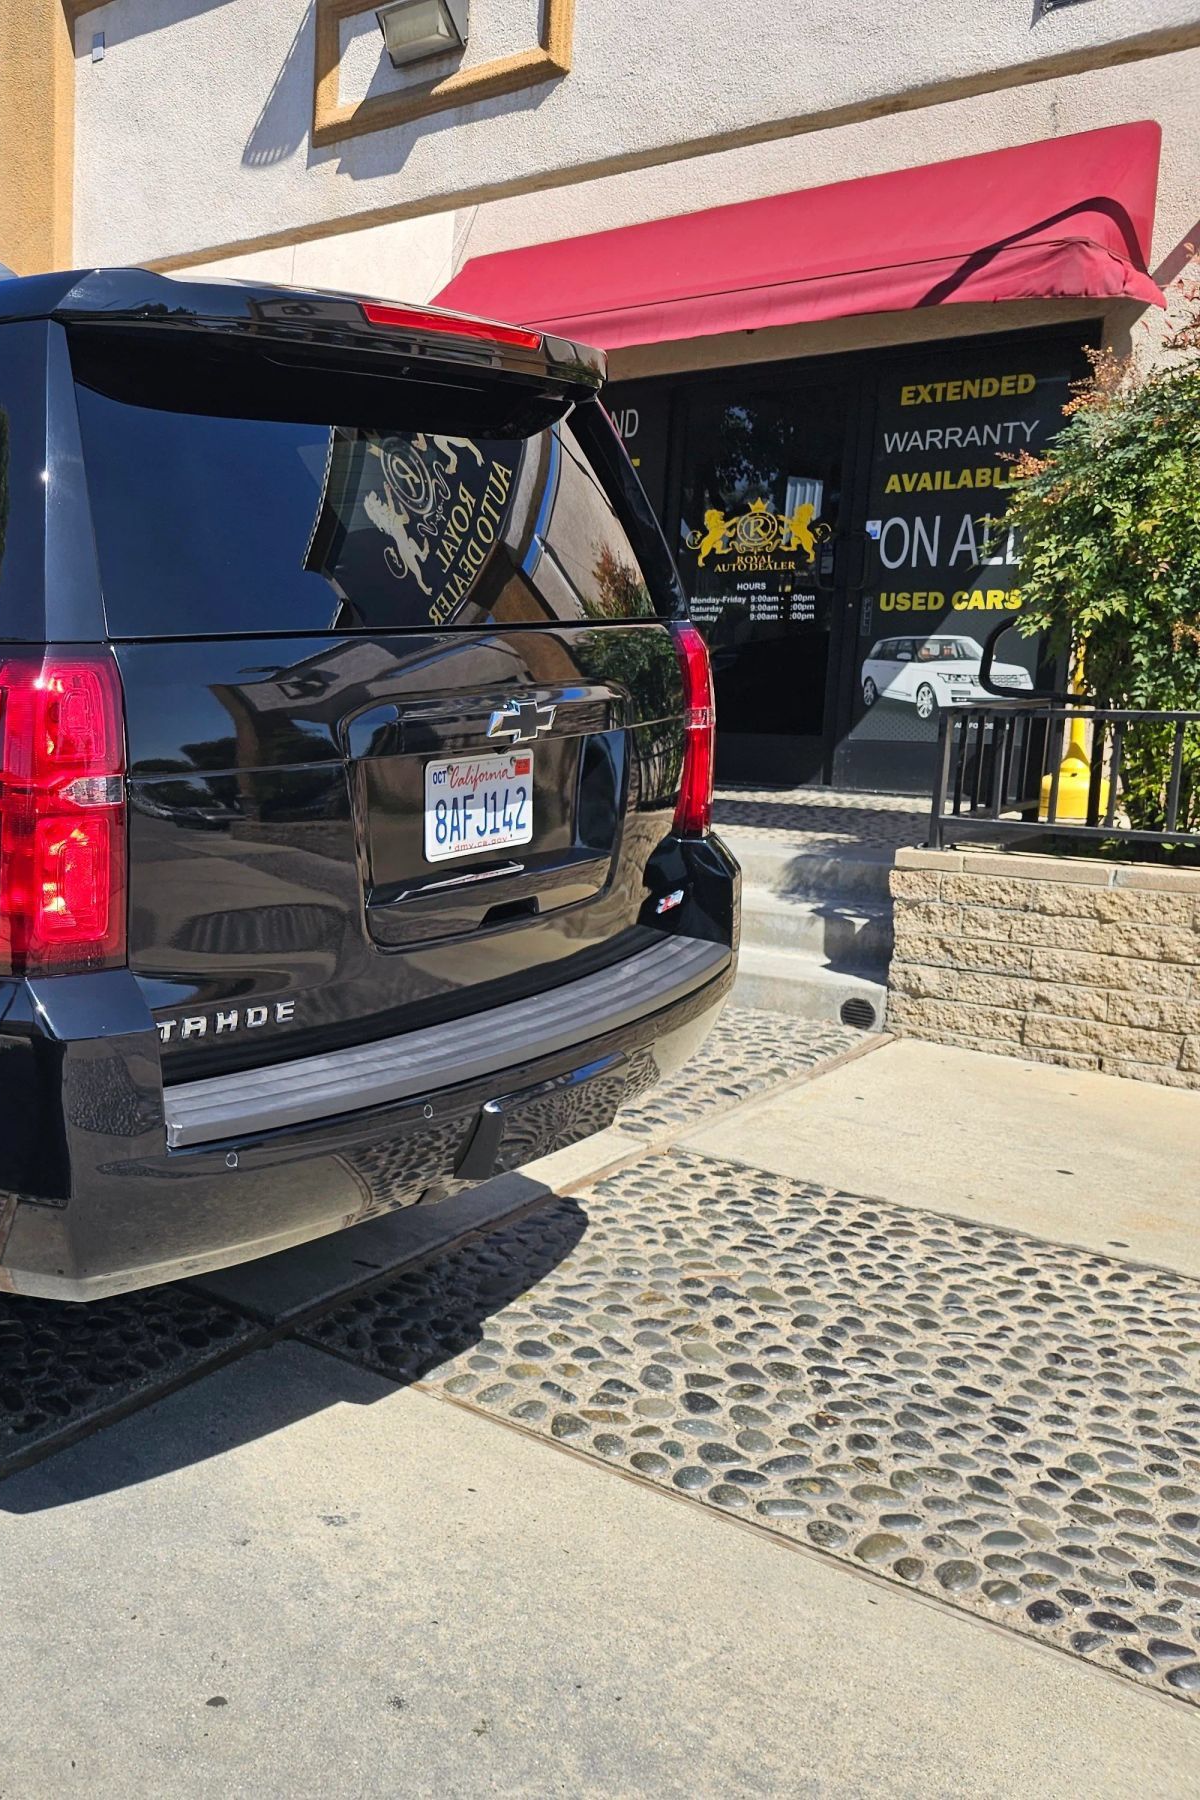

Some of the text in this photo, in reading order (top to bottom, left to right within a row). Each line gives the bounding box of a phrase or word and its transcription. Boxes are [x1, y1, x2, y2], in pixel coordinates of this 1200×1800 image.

[900, 373, 1037, 406] EXTENDED
[884, 420, 1040, 454] WARRANTY
[879, 515, 941, 570] ON
[714, 560, 796, 573] AUTO DEALER
[736, 554, 775, 565] ROYAL
[736, 582, 767, 591] HOURS
[690, 595, 747, 605] Monday-Friday
[750, 594, 779, 603] 9:00am
[690, 605, 724, 614] Saturday
[750, 603, 779, 612] 9:00am
[879, 588, 1023, 612] USED CARS
[749, 613, 778, 621] 9:00am
[432, 770, 447, 785] OCT
[449, 764, 515, 792] California
[435, 786, 527, 844] 8AFJ142
[454, 837, 508, 852] dmv.ca.gov
[155, 1000, 295, 1043] TAHOE
